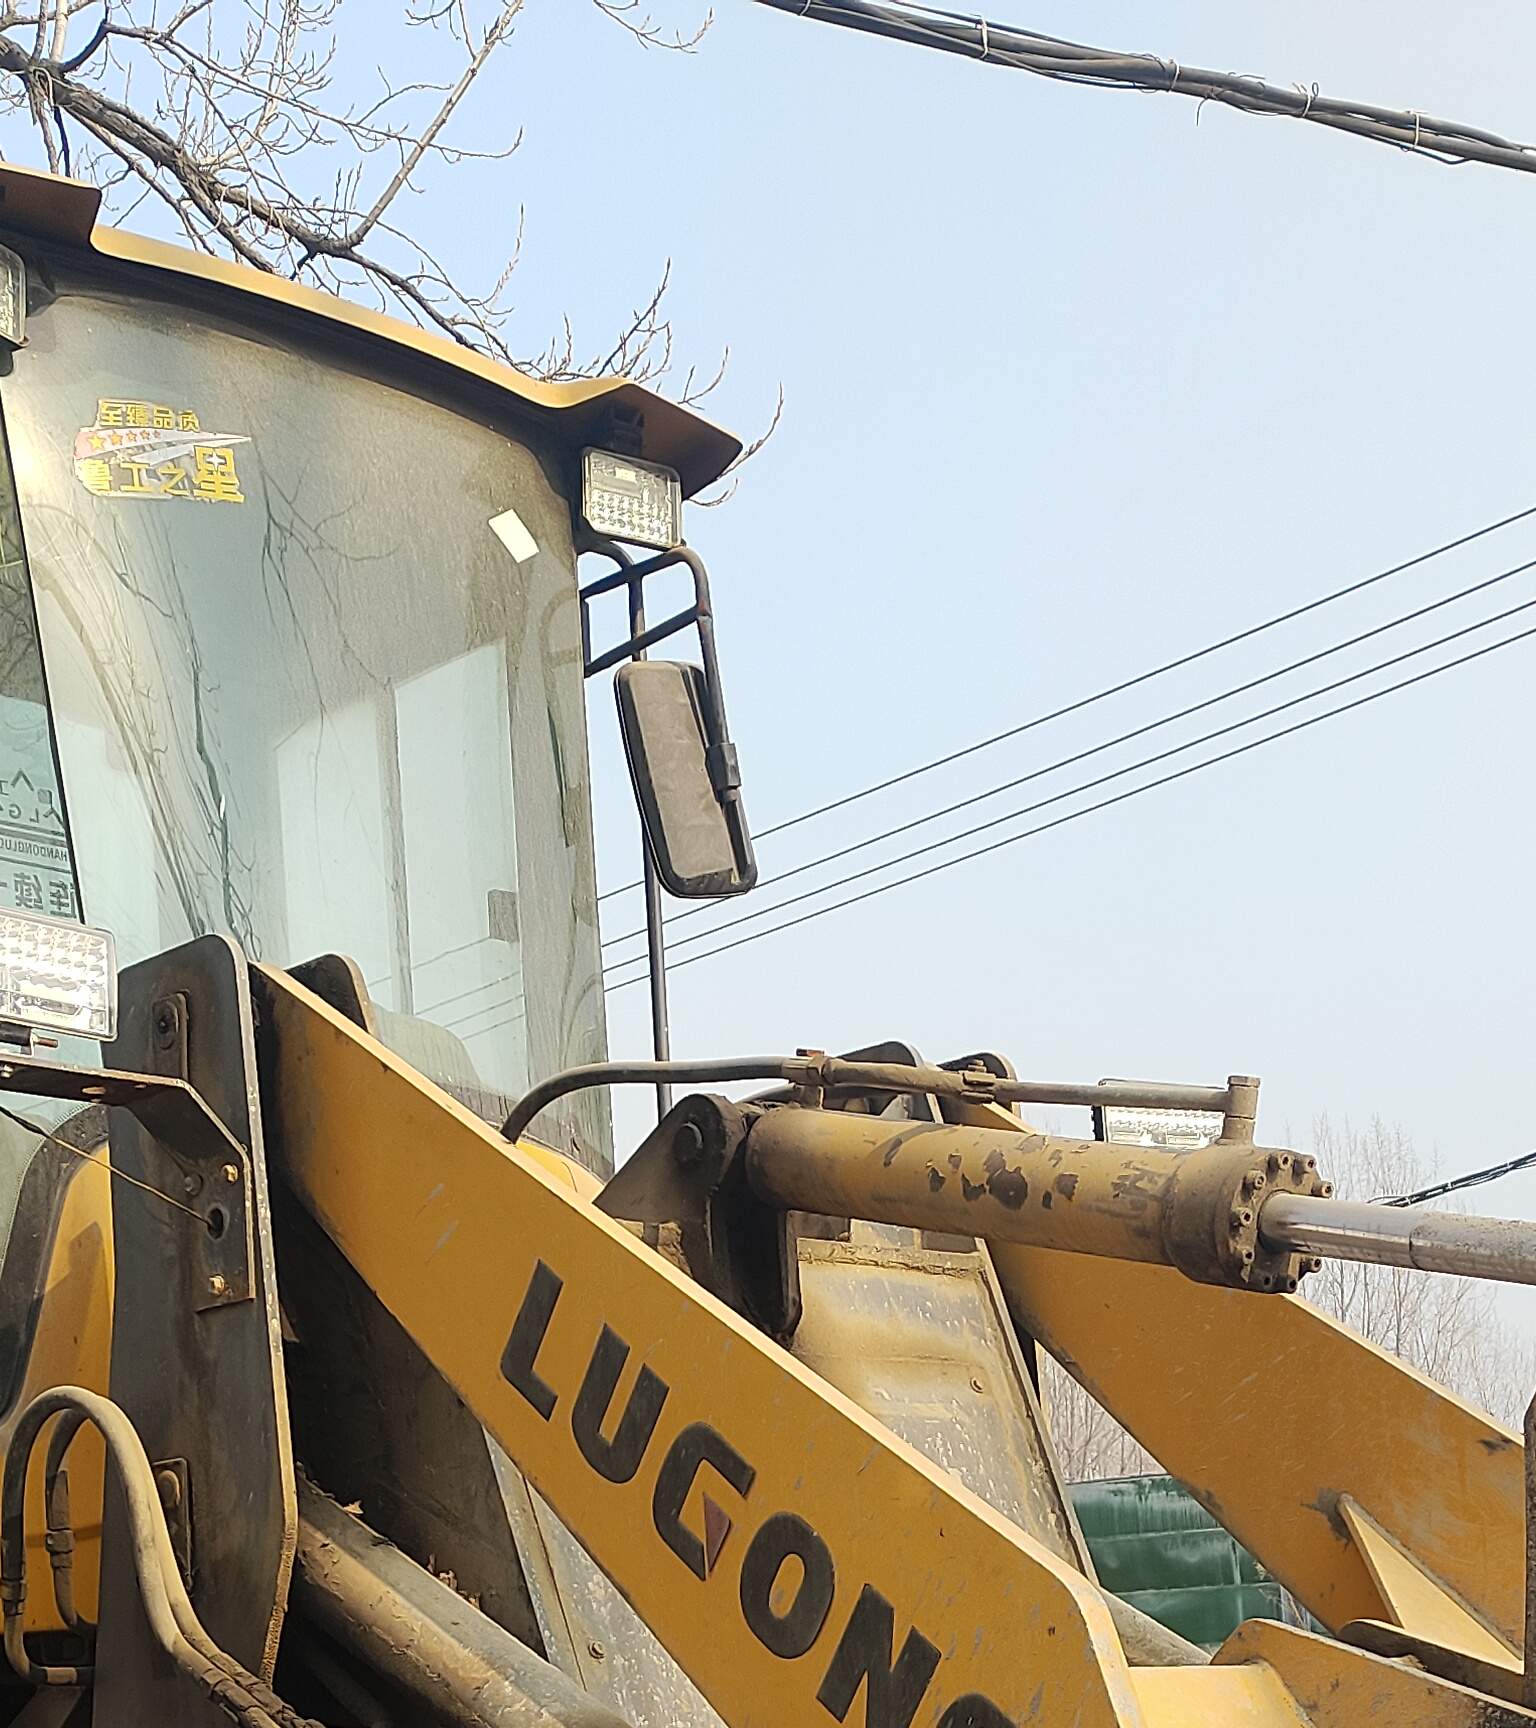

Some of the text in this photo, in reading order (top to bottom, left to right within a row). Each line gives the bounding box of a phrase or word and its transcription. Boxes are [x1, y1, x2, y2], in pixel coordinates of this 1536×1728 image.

[99, 402, 200, 432] 至臻品质
[83, 446, 245, 503] 鲁工之星
